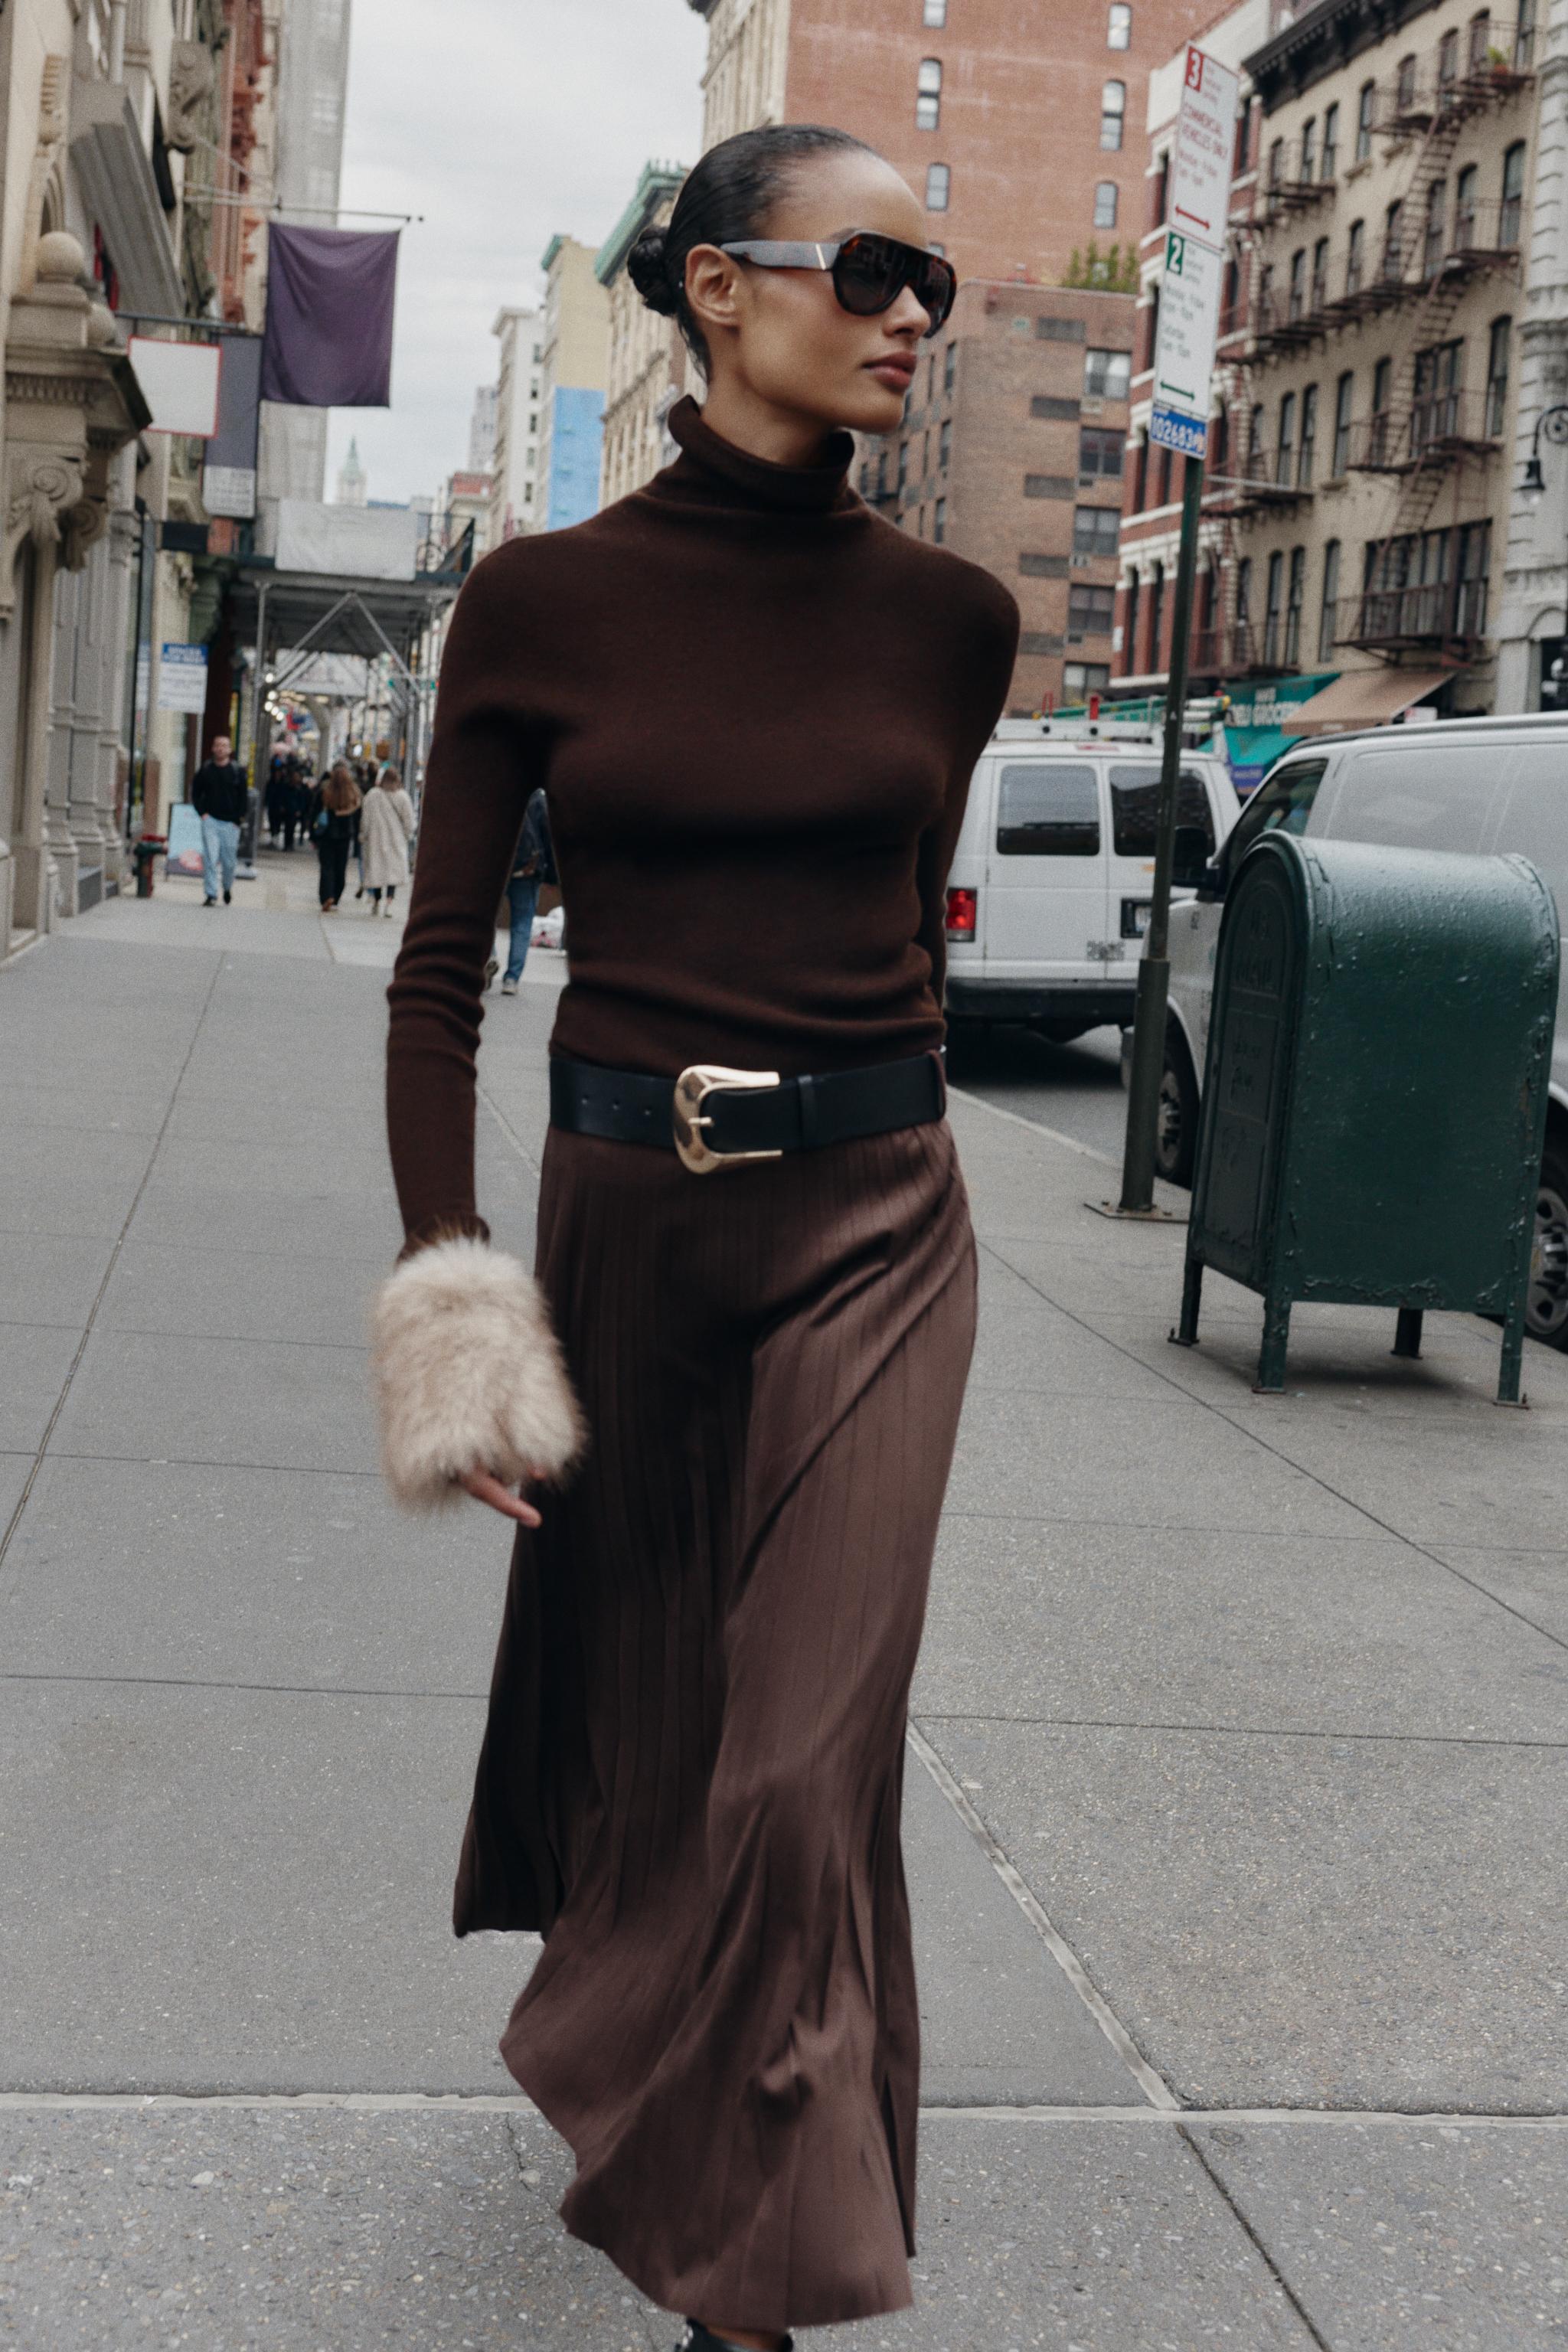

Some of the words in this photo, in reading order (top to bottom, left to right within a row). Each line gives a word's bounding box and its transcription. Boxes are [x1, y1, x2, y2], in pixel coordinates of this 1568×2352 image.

[1188, 51, 1200, 88] 3
[1169, 237, 1181, 273] 2
[1253, 701, 1302, 726] GROCE
